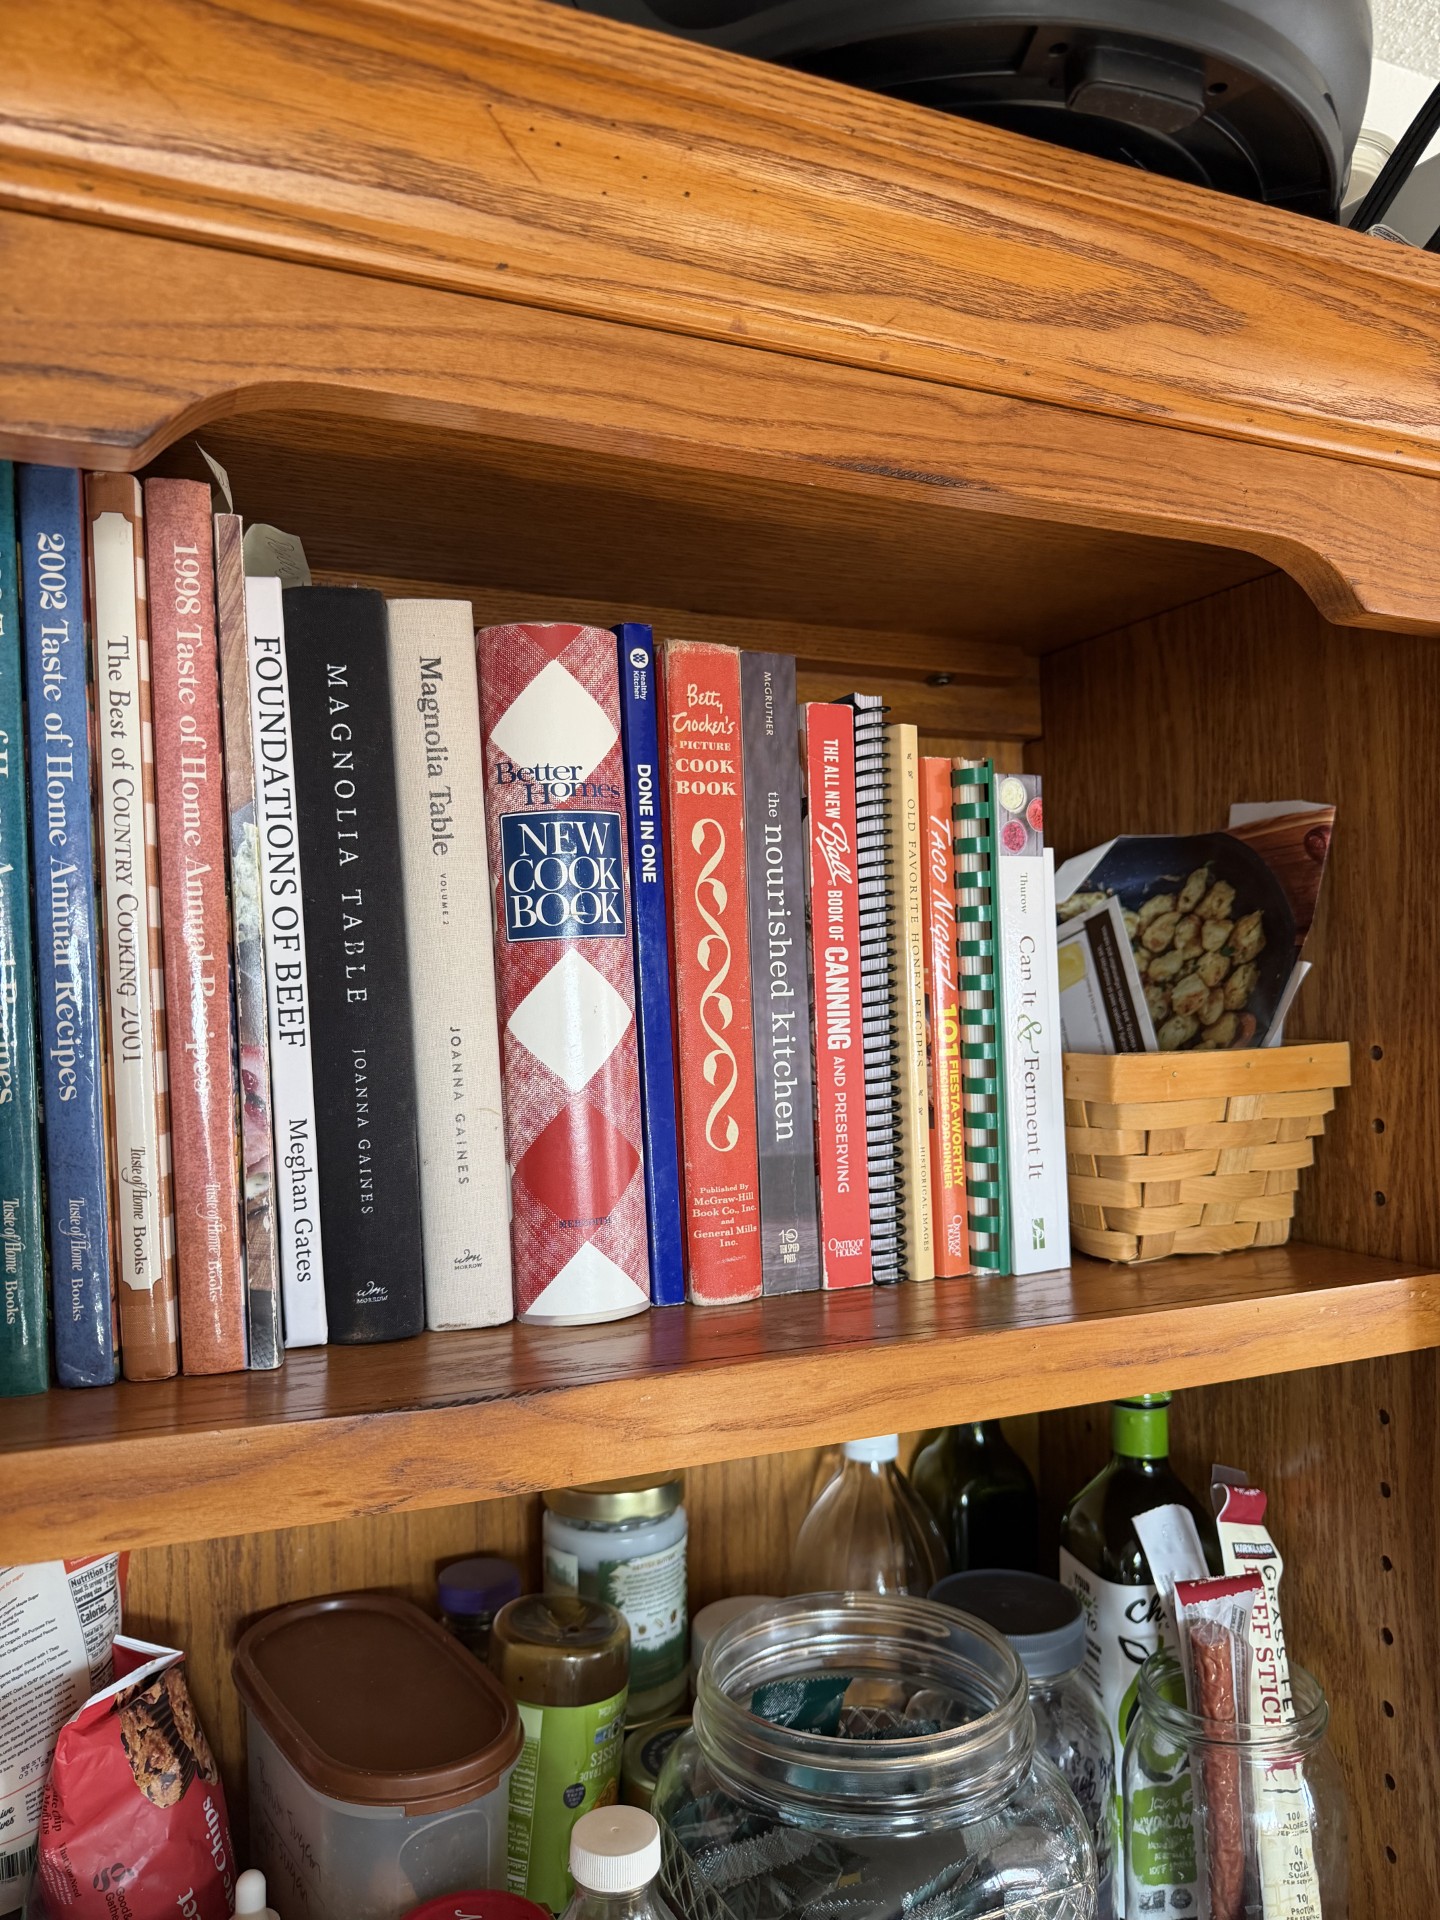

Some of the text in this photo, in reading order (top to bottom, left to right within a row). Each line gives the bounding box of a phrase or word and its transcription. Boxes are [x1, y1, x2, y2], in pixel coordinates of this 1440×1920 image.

[173, 540, 201, 615] 1998
[176, 624, 203, 705] Taste
[633, 670, 641, 700] Kitchen
[640, 670, 648, 701] Healthy
[686, 683, 723, 714] Betty
[764, 671, 773, 736] McGRUTHER
[179, 715, 207, 749] of
[672, 711, 736, 736] Crocker's
[416, 655, 455, 857] Magnolia Table
[680, 740, 731, 751] PICTURE
[494, 761, 583, 785] Better
[675, 758, 736, 774] COOK
[181, 753, 207, 847] Home
[523, 782, 621, 806] Homes
[676, 780, 737, 796] BOOK
[37, 532, 82, 1102] 2002 Taste of Home Annual Recipes
[326, 662, 368, 1003] MAGNOLIA TABLE
[637, 764, 657, 884] DONE IN ONE
[107, 635, 142, 1064] The Best of COUNTRY COOKING 2001
[254, 636, 307, 1048] FOUNDATIONS OF BEEF
[517, 820, 611, 857] NEW
[929, 815, 951, 884] TACO
[508, 856, 621, 893] COOK
[185, 857, 215, 962] Annual
[440, 872, 449, 917] VOLUME
[510, 890, 624, 929] BOOK
[1020, 872, 1029, 914] Thurow
[907, 798, 924, 1067] OLD FAVORITE HONEY RECIPES
[765, 791, 798, 1142] the nourished kitchen
[816, 739, 853, 1194] THE ALL NEW Ball BOOK OF CANNING AND PRESERVING
[1017, 935, 1044, 1180] Can It & Ferment It
[450, 1026, 470, 1186] JOANNA GAINES
[937, 1003, 964, 1187] 101 FIESTA-WORTHY
[352, 1048, 374, 1215] JOANNA GAINES
[130, 1146, 146, 1177] Taste
[942, 1142, 953, 1189] DINNER
[131, 1189, 151, 1220] Home
[284, 1118, 314, 1283] Meghan Gates
[694, 1192, 754, 1206] McGraw-Hill
[700, 1183, 749, 1194] Published By
[3, 1198, 19, 1230] Taste
[68, 1197, 85, 1227] Taste
[692, 1208, 719, 1218] Book
[741, 1204, 757, 1213] Inc.
[694, 1224, 757, 1239] General Mills
[720, 1239, 738, 1248] Inc.
[828, 1237, 864, 1251] Oxmoor
[922, 1212, 930, 1253] IMAGES
[5, 1240, 25, 1273] Home
[70, 1240, 91, 1271] Home
[132, 1225, 147, 1276] Books
[454, 1262, 483, 1271] MORROW
[5, 1280, 19, 1325] Books
[71, 1278, 84, 1322] Books
[1234, 1543, 1274, 1554] KIRKLAND
[70, 1565, 104, 1588] Nutrition
[75, 1586, 102, 1604] Serving size
[80, 1603, 107, 1624] Calories
[20, 1756, 42, 1773] BEST
[202, 1795, 226, 1872] Chips
[1289, 1861, 1309, 1872] TOTAL
[1289, 1871, 1310, 1879] SUGAR
[71, 1877, 82, 1898] Need
